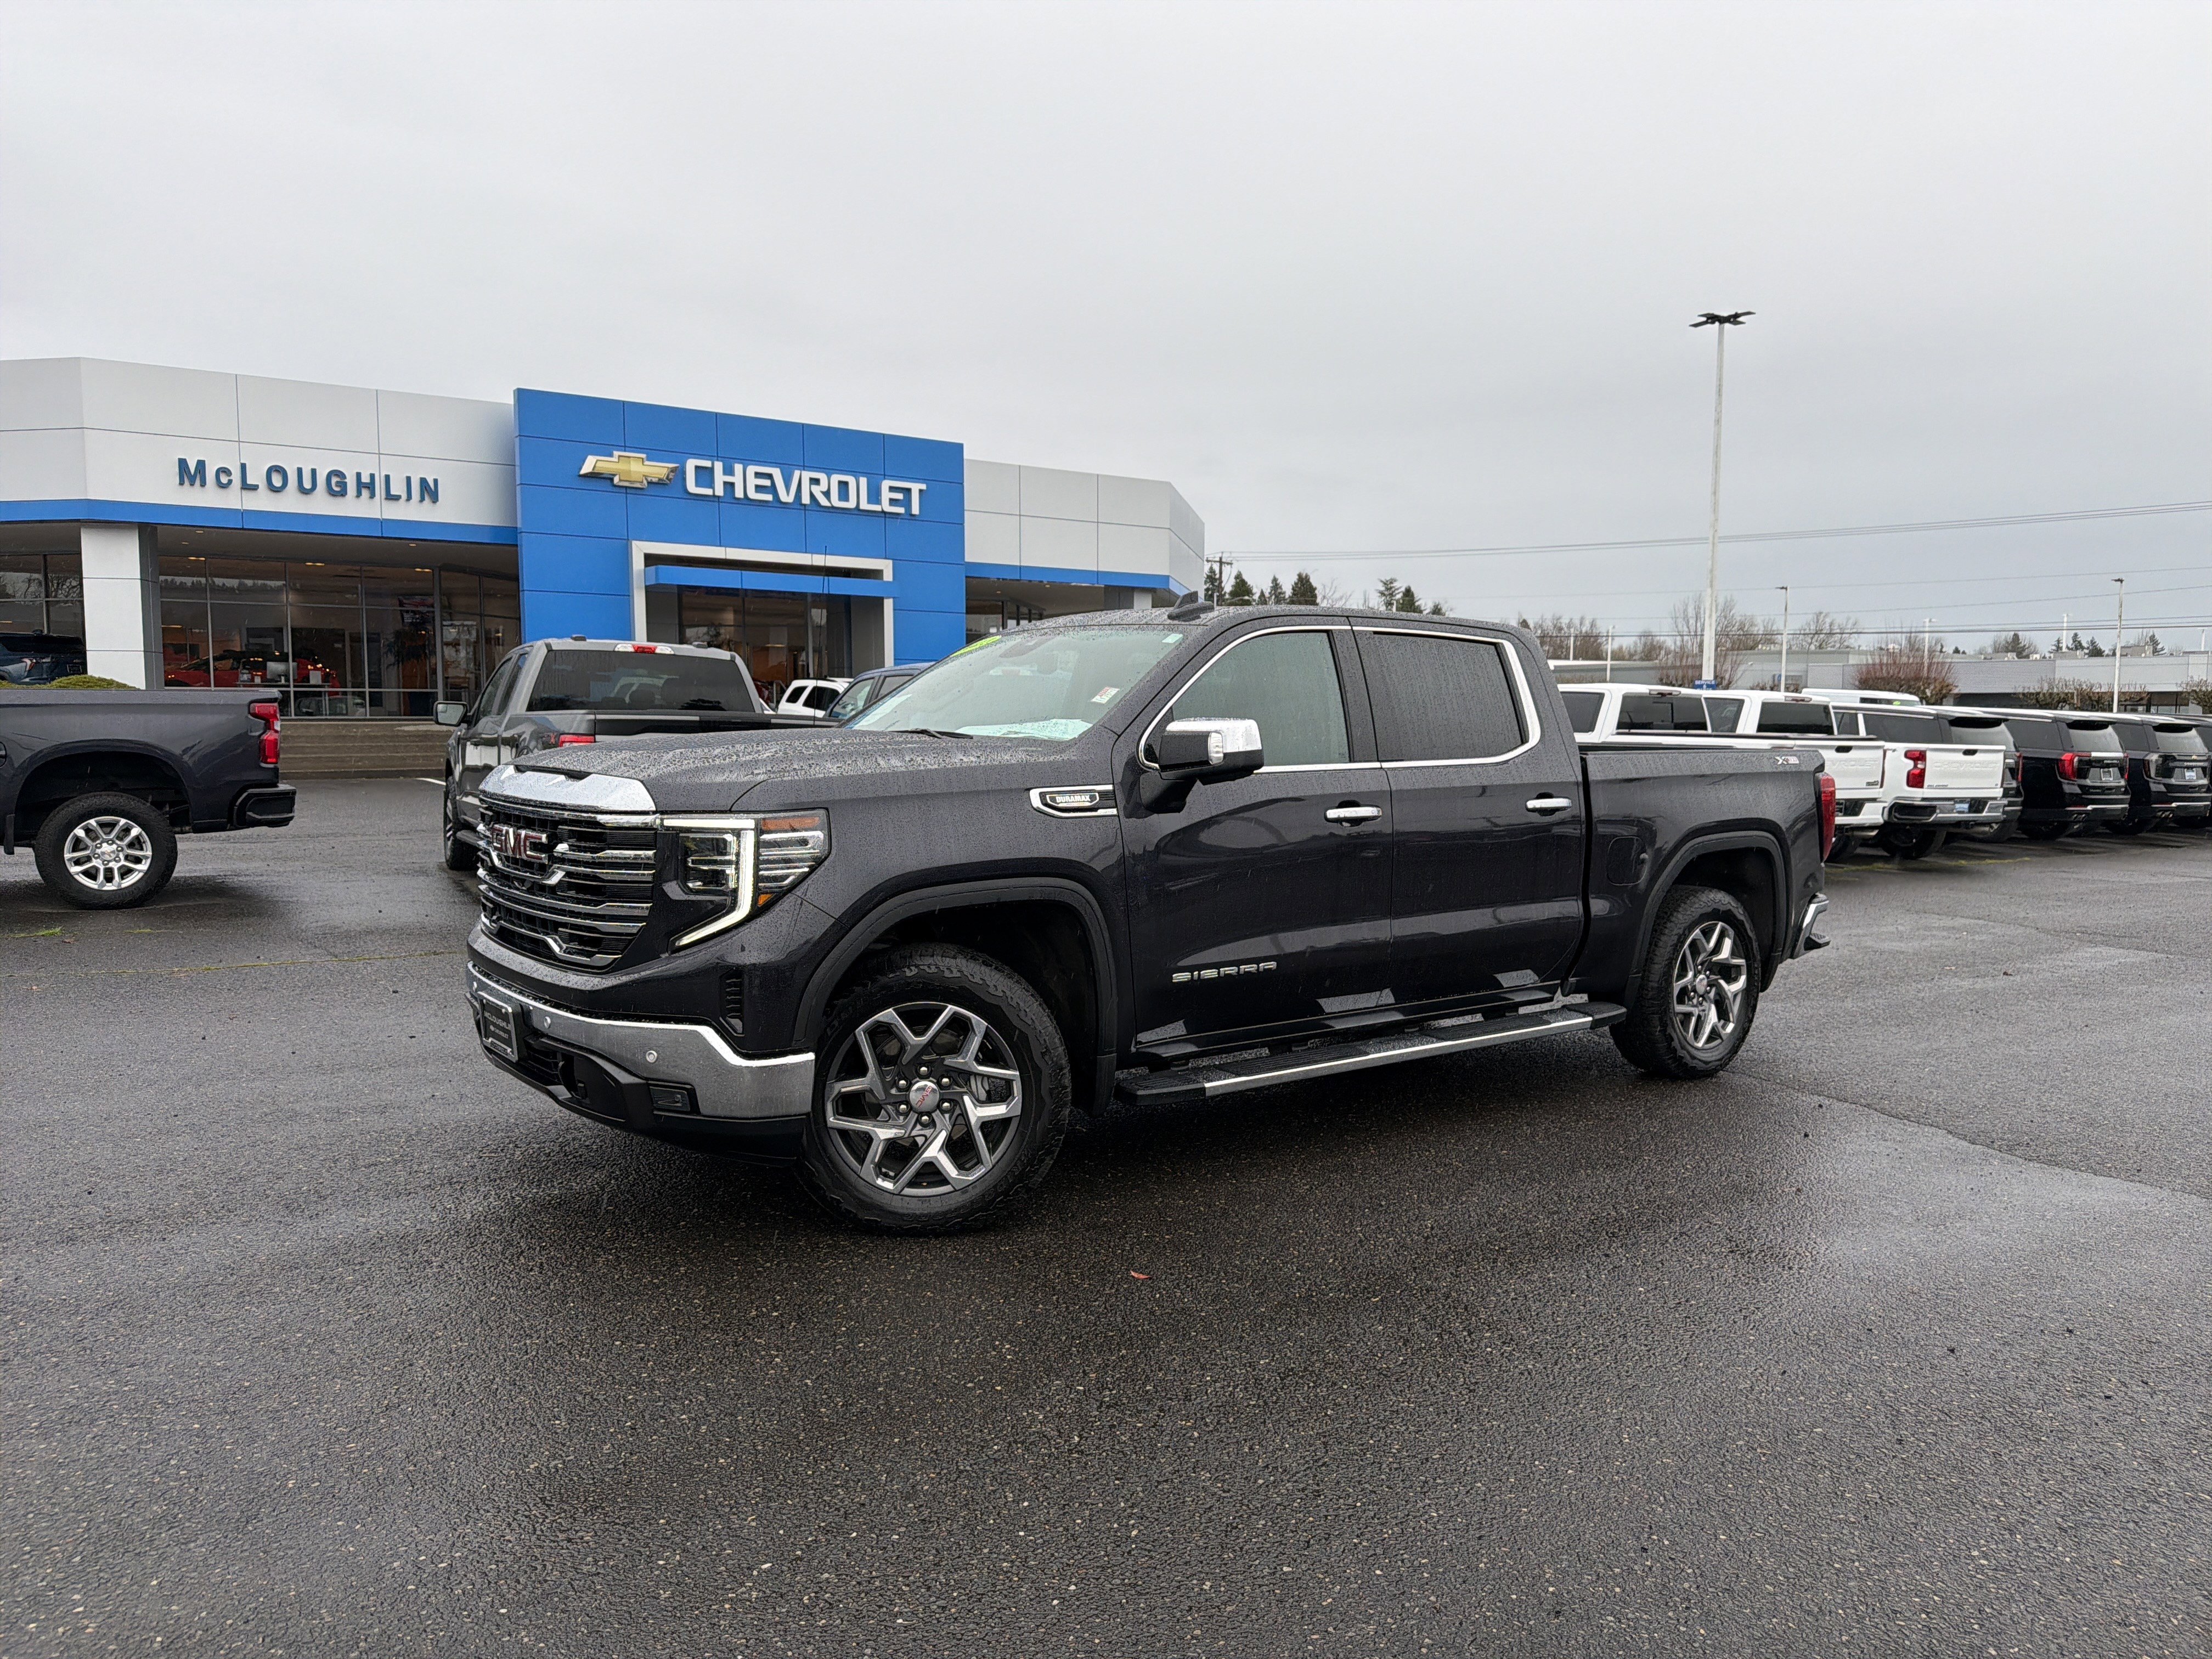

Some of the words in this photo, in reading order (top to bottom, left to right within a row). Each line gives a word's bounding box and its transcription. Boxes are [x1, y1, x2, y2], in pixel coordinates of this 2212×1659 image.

[178, 458, 439, 503] McLOUGHLIN
[685, 459, 927, 516] CHEVROLET
[1055, 794, 1091, 803] DURAMAX
[491, 823, 549, 865] GMC
[1172, 961, 1277, 983] SIERRA
[915, 1085, 934, 1109] GMC
